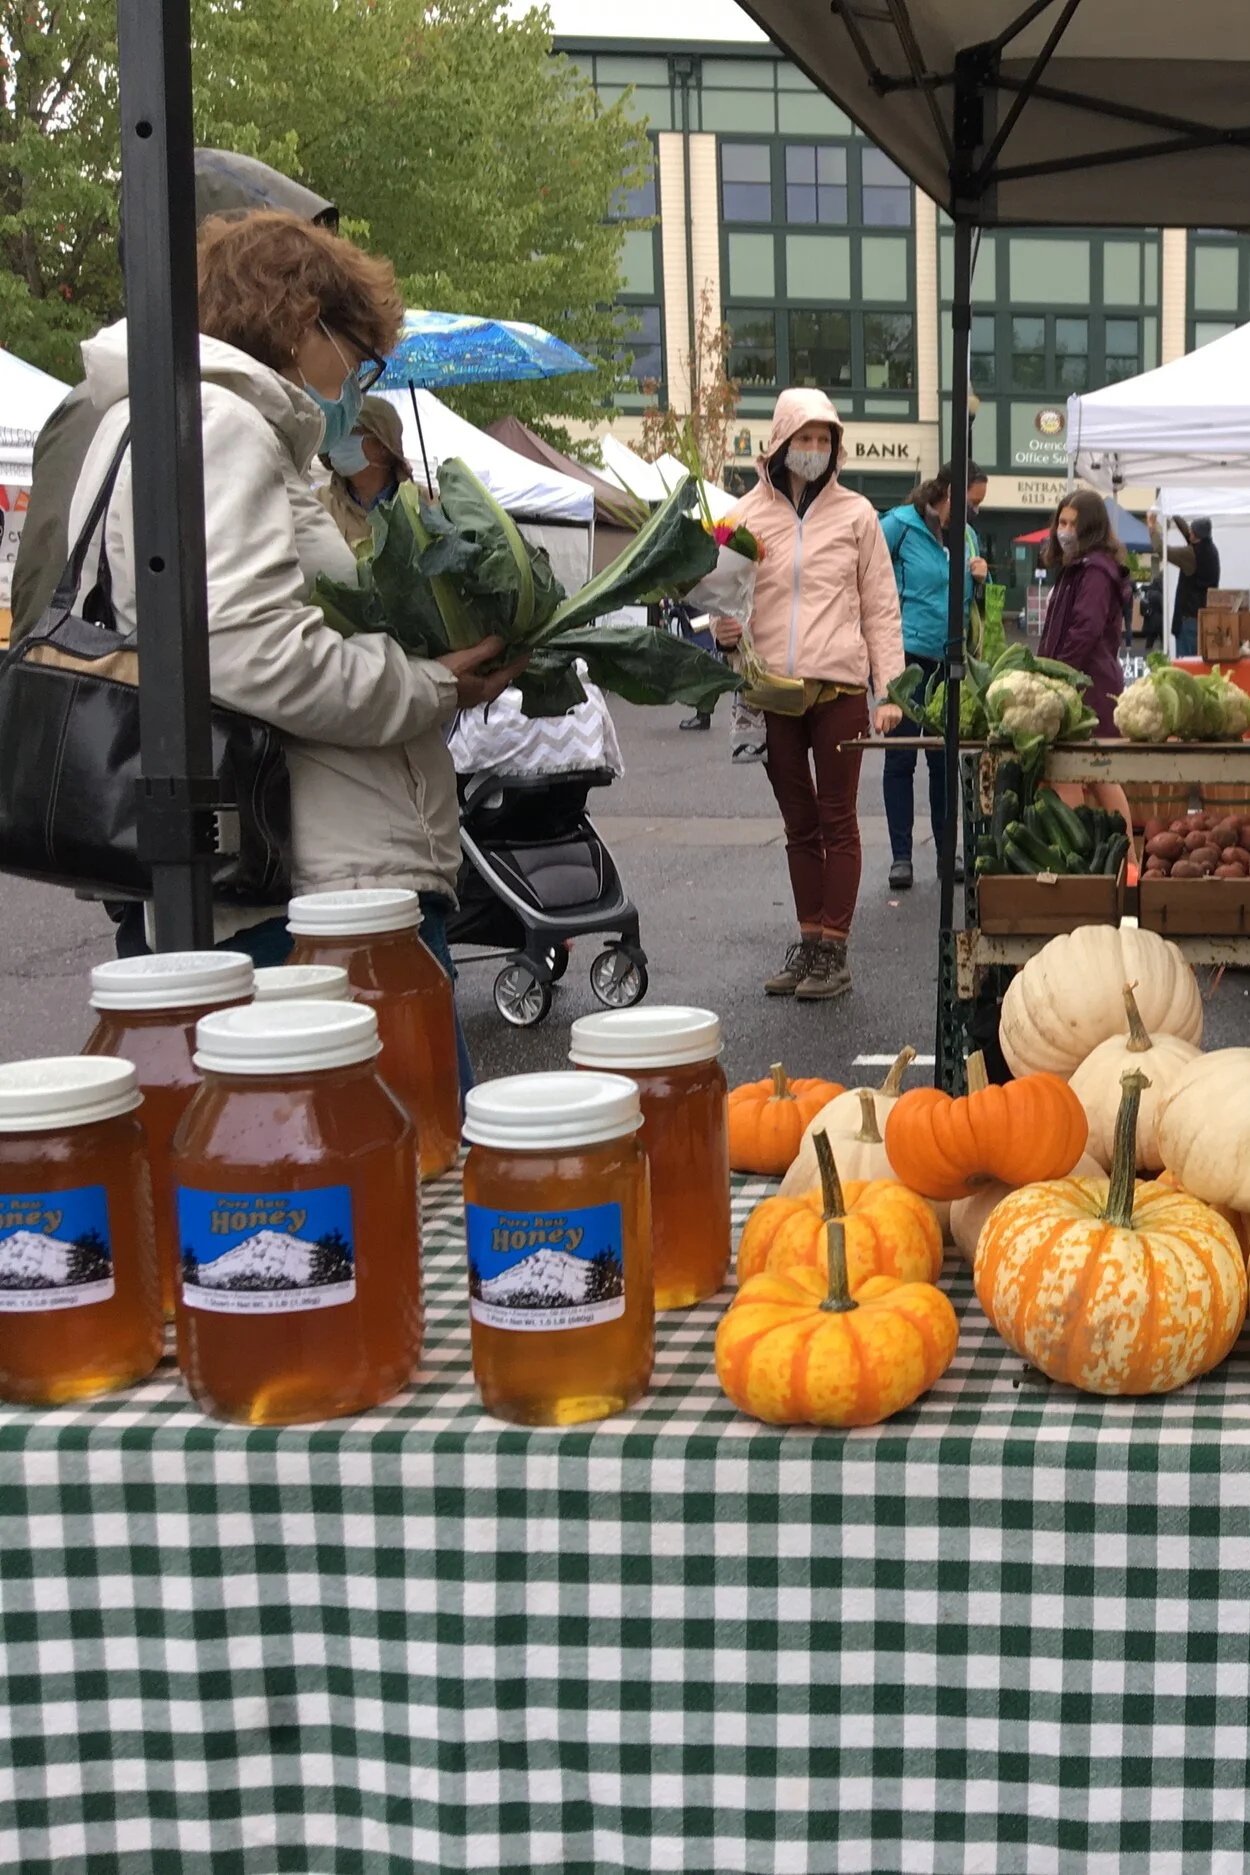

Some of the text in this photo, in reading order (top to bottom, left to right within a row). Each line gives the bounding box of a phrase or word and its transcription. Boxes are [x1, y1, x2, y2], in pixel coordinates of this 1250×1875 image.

[855, 442, 909, 458] BANK
[1015, 451, 1049, 463] Office
[218, 1198, 289, 1209] Pure Raw
[0, 1209, 63, 1234] ney
[210, 1208, 308, 1234] Honey
[499, 1216, 568, 1228] Pure Raw
[491, 1226, 584, 1252] Honey
